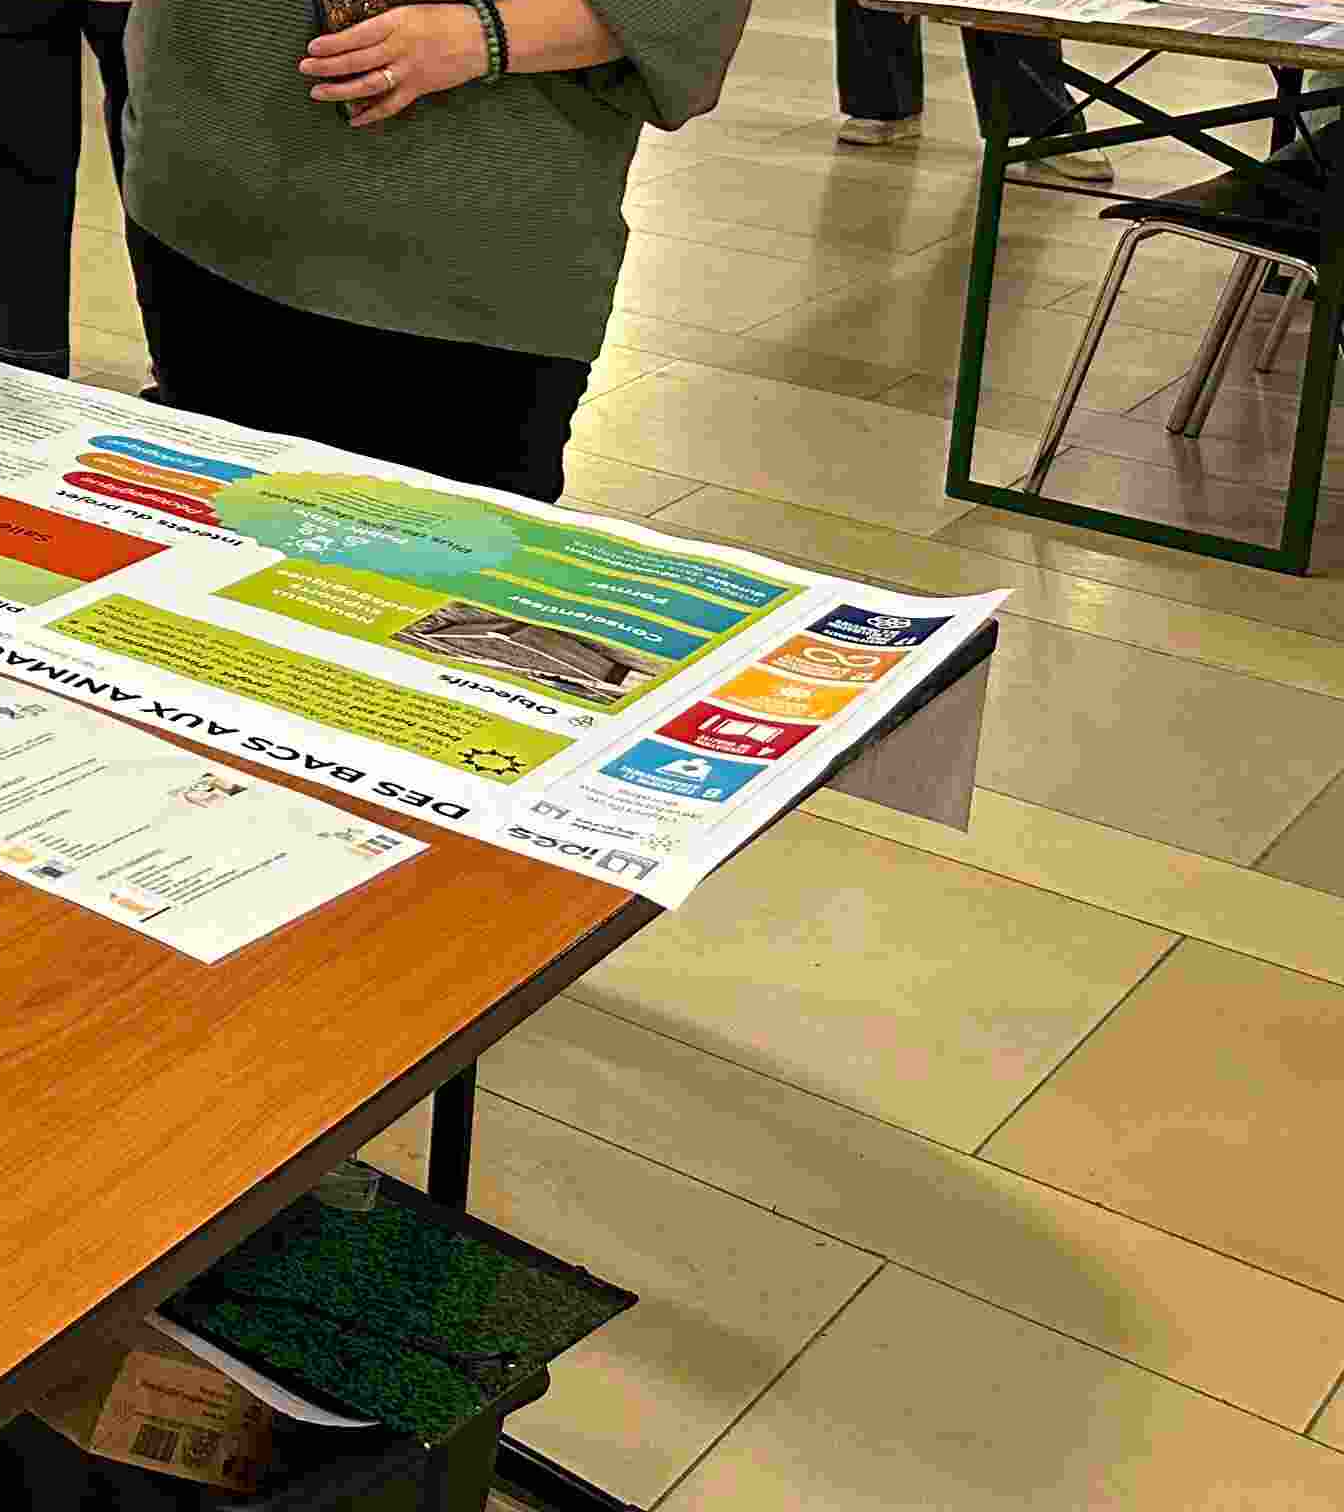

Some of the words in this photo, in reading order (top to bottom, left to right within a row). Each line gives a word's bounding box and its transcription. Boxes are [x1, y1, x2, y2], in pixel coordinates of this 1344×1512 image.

[56, 490, 121, 512] projet
[124, 510, 153, 521] du
[507, 594, 665, 645] Conscientiser
[147, 698, 240, 736] AUX
[440, 674, 558, 717] Objectifs
[241, 734, 368, 785] BACS
[373, 779, 470, 823] DES
